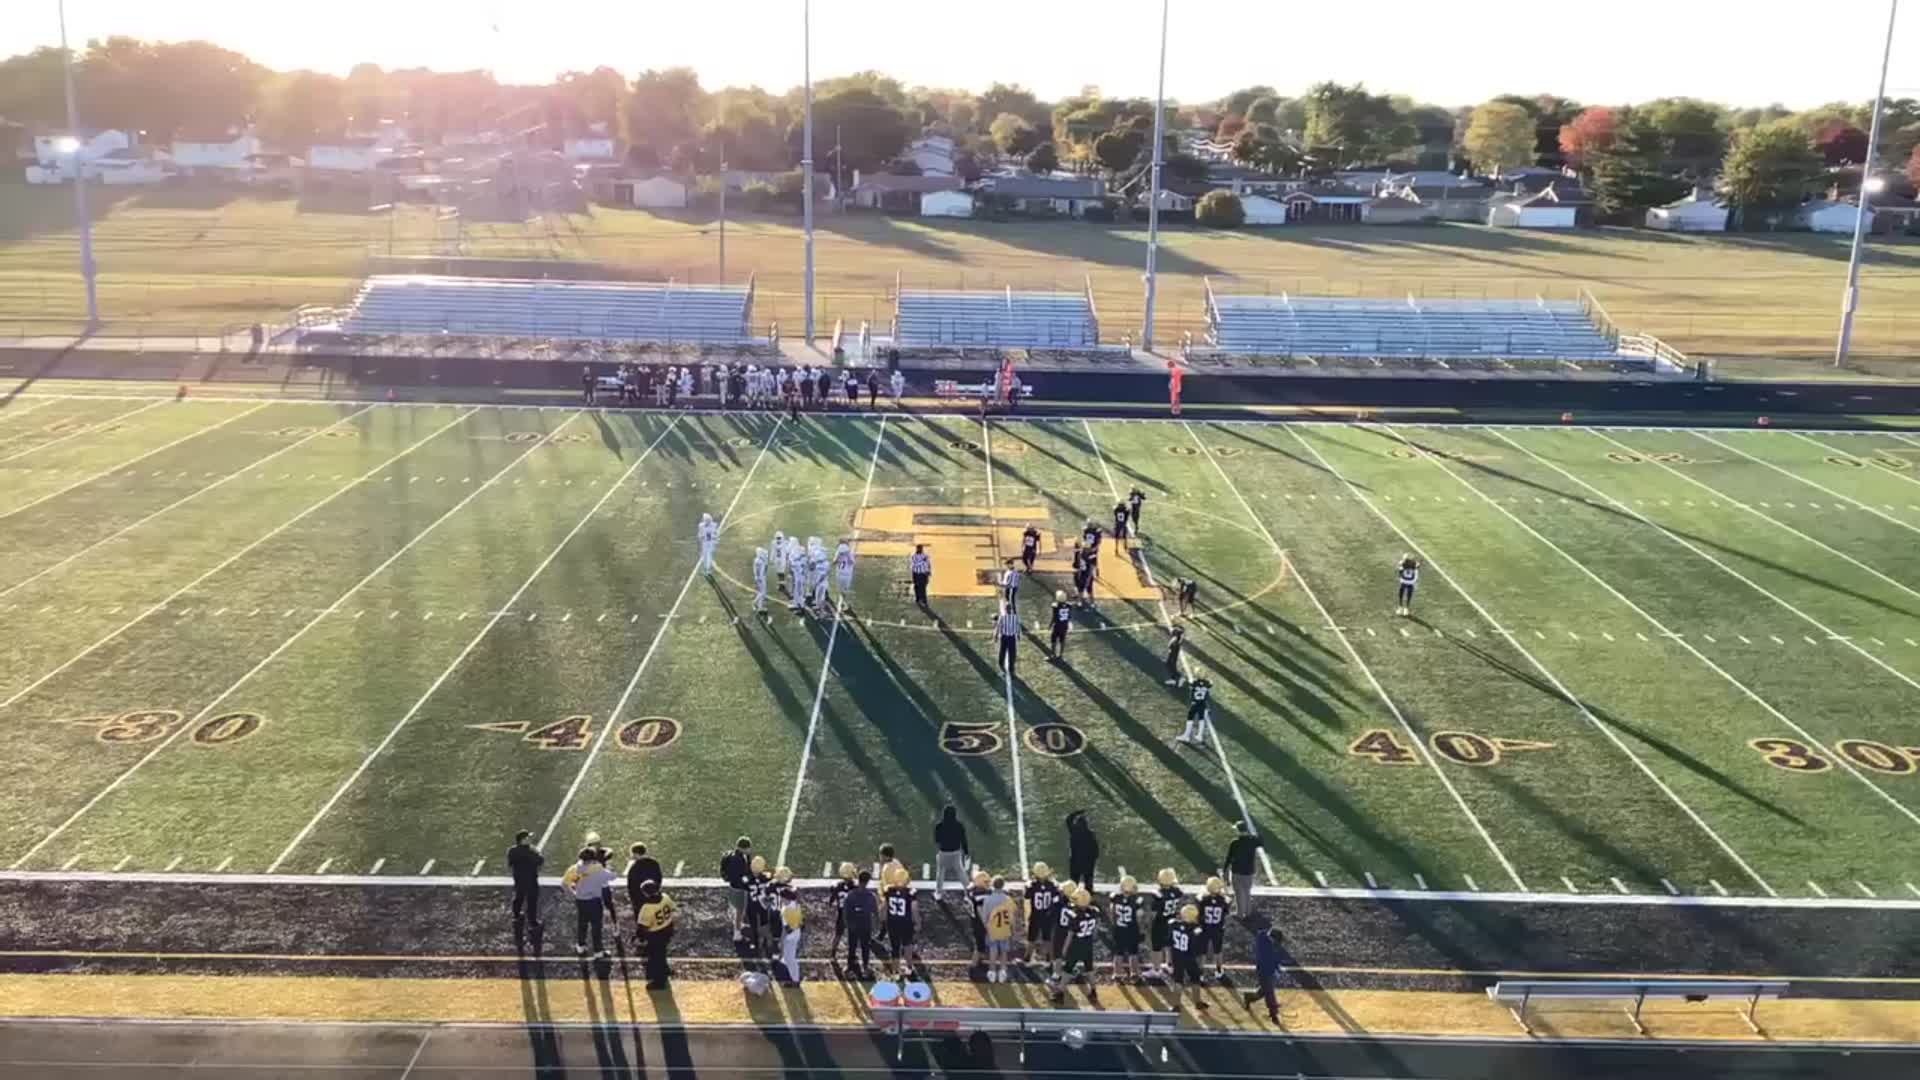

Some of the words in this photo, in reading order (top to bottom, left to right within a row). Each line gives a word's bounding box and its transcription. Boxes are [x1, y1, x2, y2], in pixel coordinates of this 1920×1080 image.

[96, 709, 267, 746] 30
[522, 714, 683, 752] 40
[938, 720, 1088, 757] 50
[1348, 728, 1502, 767] 40
[1748, 736, 1918, 775] 30
[888, 896, 906, 916] 53
[1034, 892, 1052, 911] 60
[1204, 906, 1223, 924] 59
